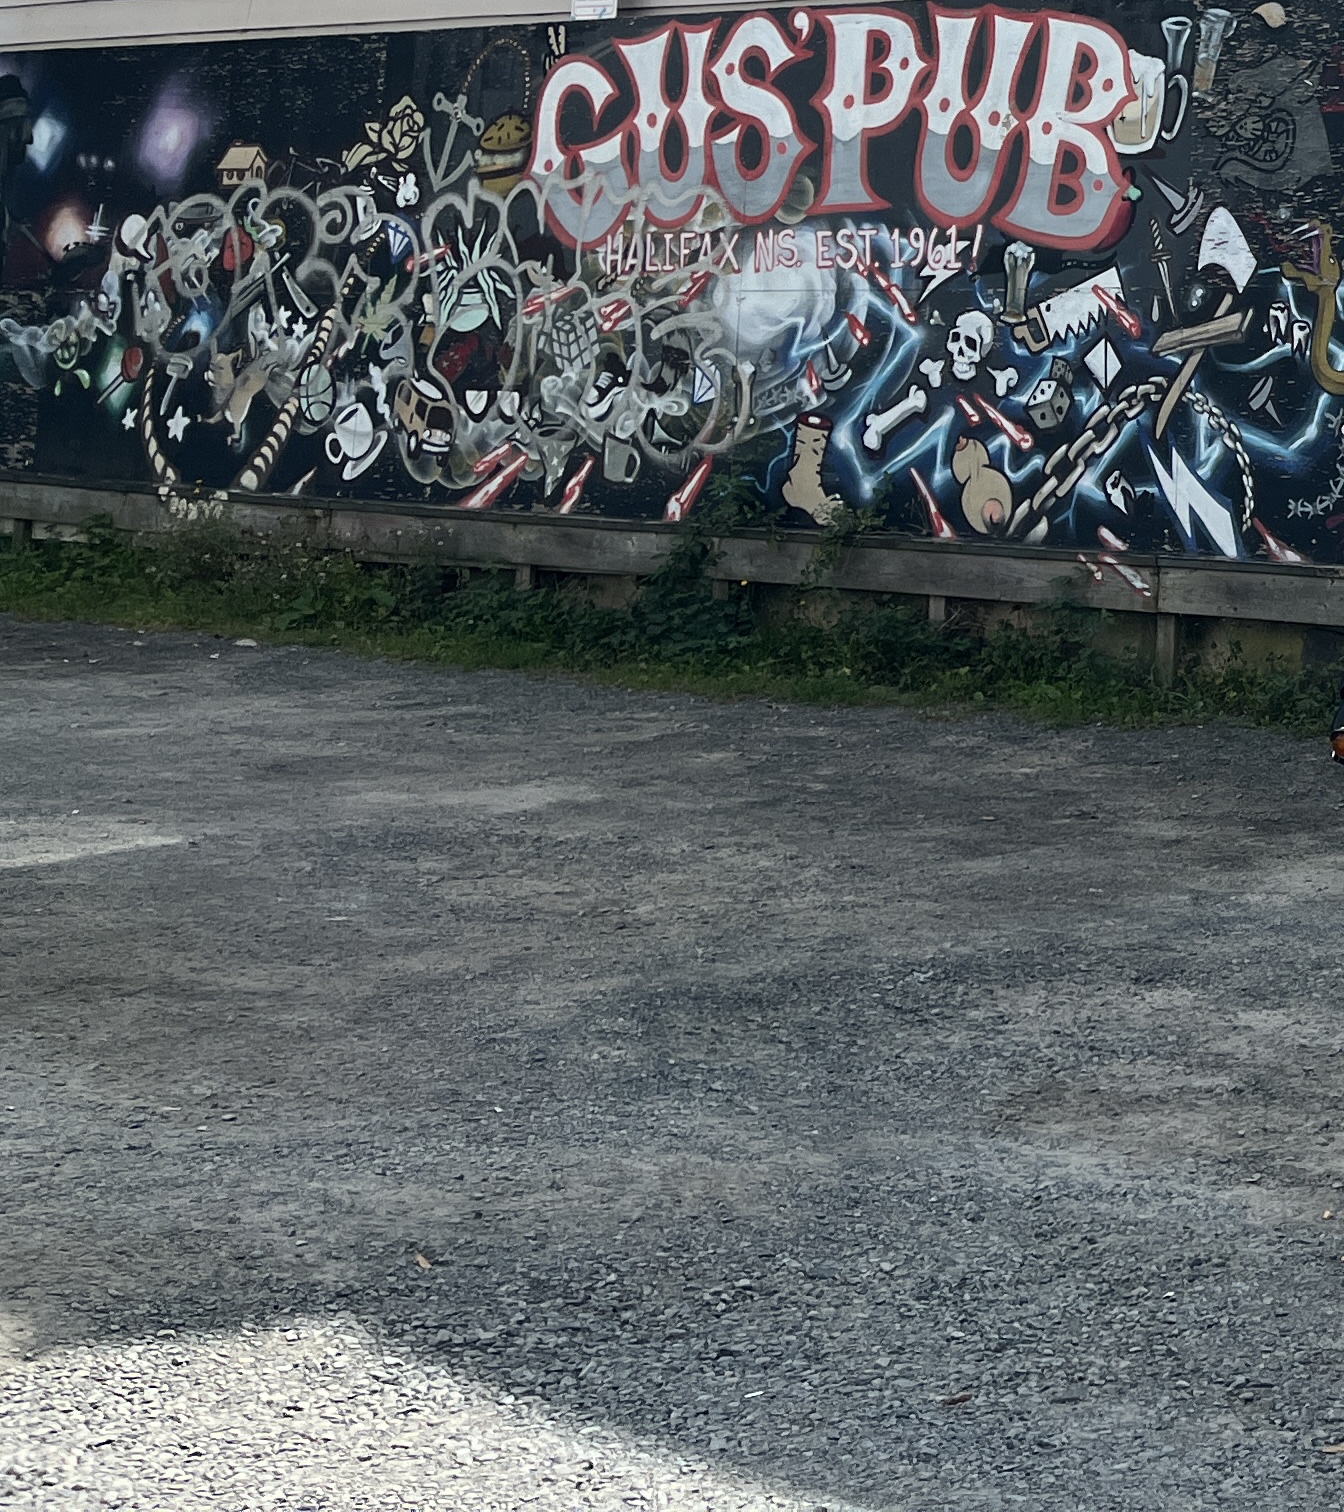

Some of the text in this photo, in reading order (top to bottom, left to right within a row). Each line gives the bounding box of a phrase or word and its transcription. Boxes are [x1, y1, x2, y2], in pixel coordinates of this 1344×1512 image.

[526, 1, 1137, 252] GUS' PUB
[604, 232, 740, 276] HALIFAX
[890, 224, 984, 272] 1961!
